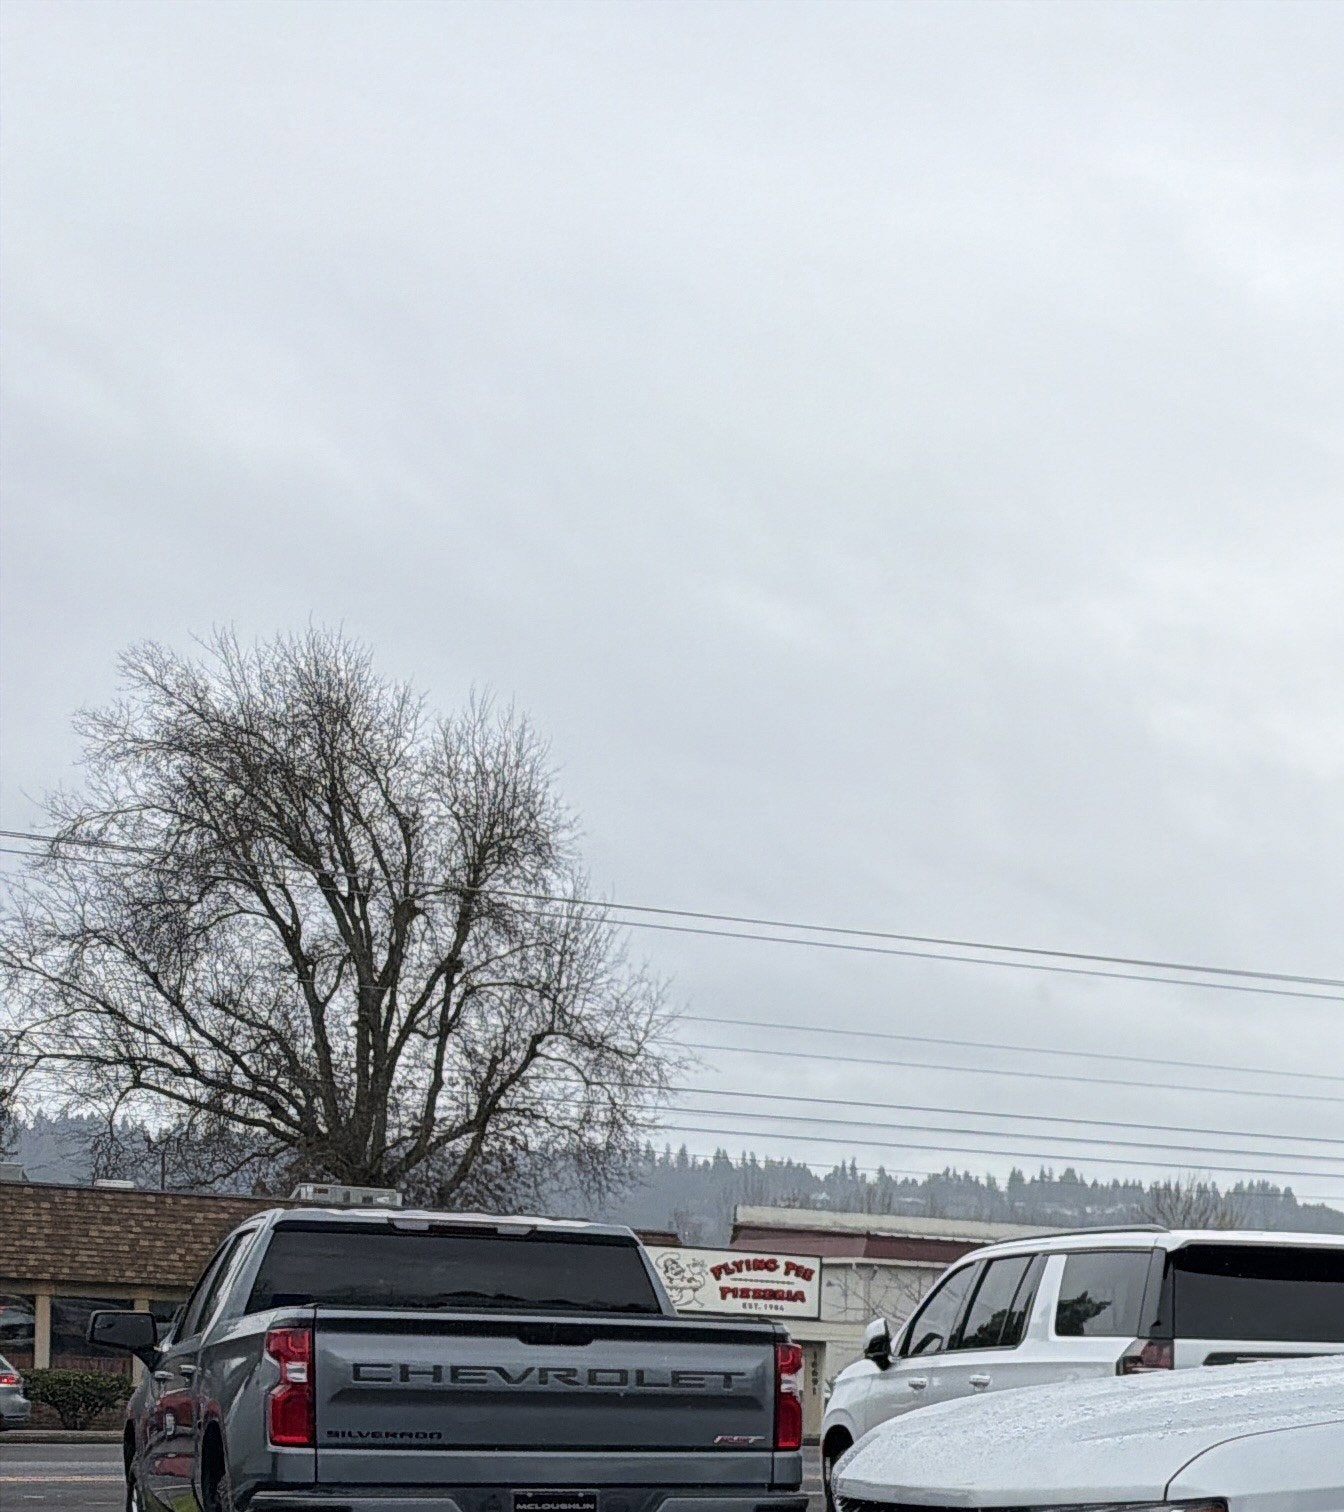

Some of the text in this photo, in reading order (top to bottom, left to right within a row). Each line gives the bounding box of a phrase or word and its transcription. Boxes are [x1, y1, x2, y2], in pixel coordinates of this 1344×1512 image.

[710, 1258, 815, 1282] FLYING PIE
[719, 1286, 806, 1303] PIZZERIA
[352, 1363, 746, 1389] CHEVROLET
[326, 1430, 442, 1439] SILVERADO
